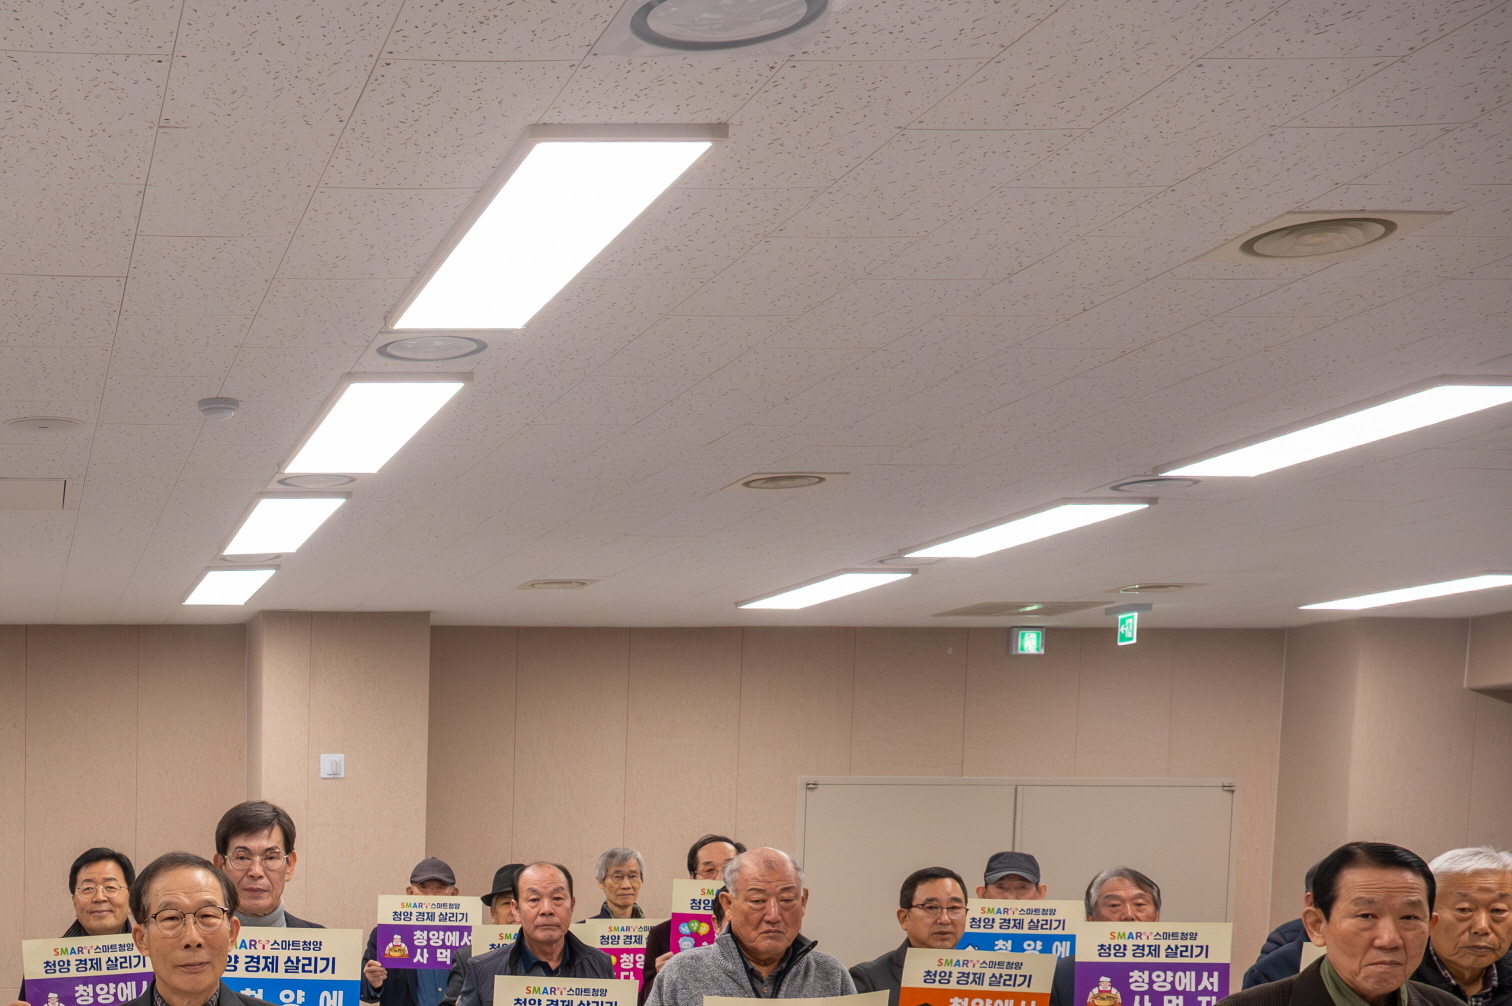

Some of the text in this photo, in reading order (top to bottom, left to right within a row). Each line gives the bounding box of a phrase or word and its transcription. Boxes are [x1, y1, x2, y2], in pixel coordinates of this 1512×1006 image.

[392, 911, 468, 923] 청양 경제 살리기
[969, 917, 1066, 931] 청양 경제 살리기
[600, 935, 643, 945] 청양 경제
[1097, 943, 1209, 959] 청양 경제 살리기
[43, 959, 70, 974] 청양
[74, 957, 101, 972] 경제
[245, 955, 277, 973] 경제
[284, 956, 336, 974] 살리기
[923, 970, 1032, 988] 청양 경제 살리기
[1129, 970, 1219, 992] 청양에서
